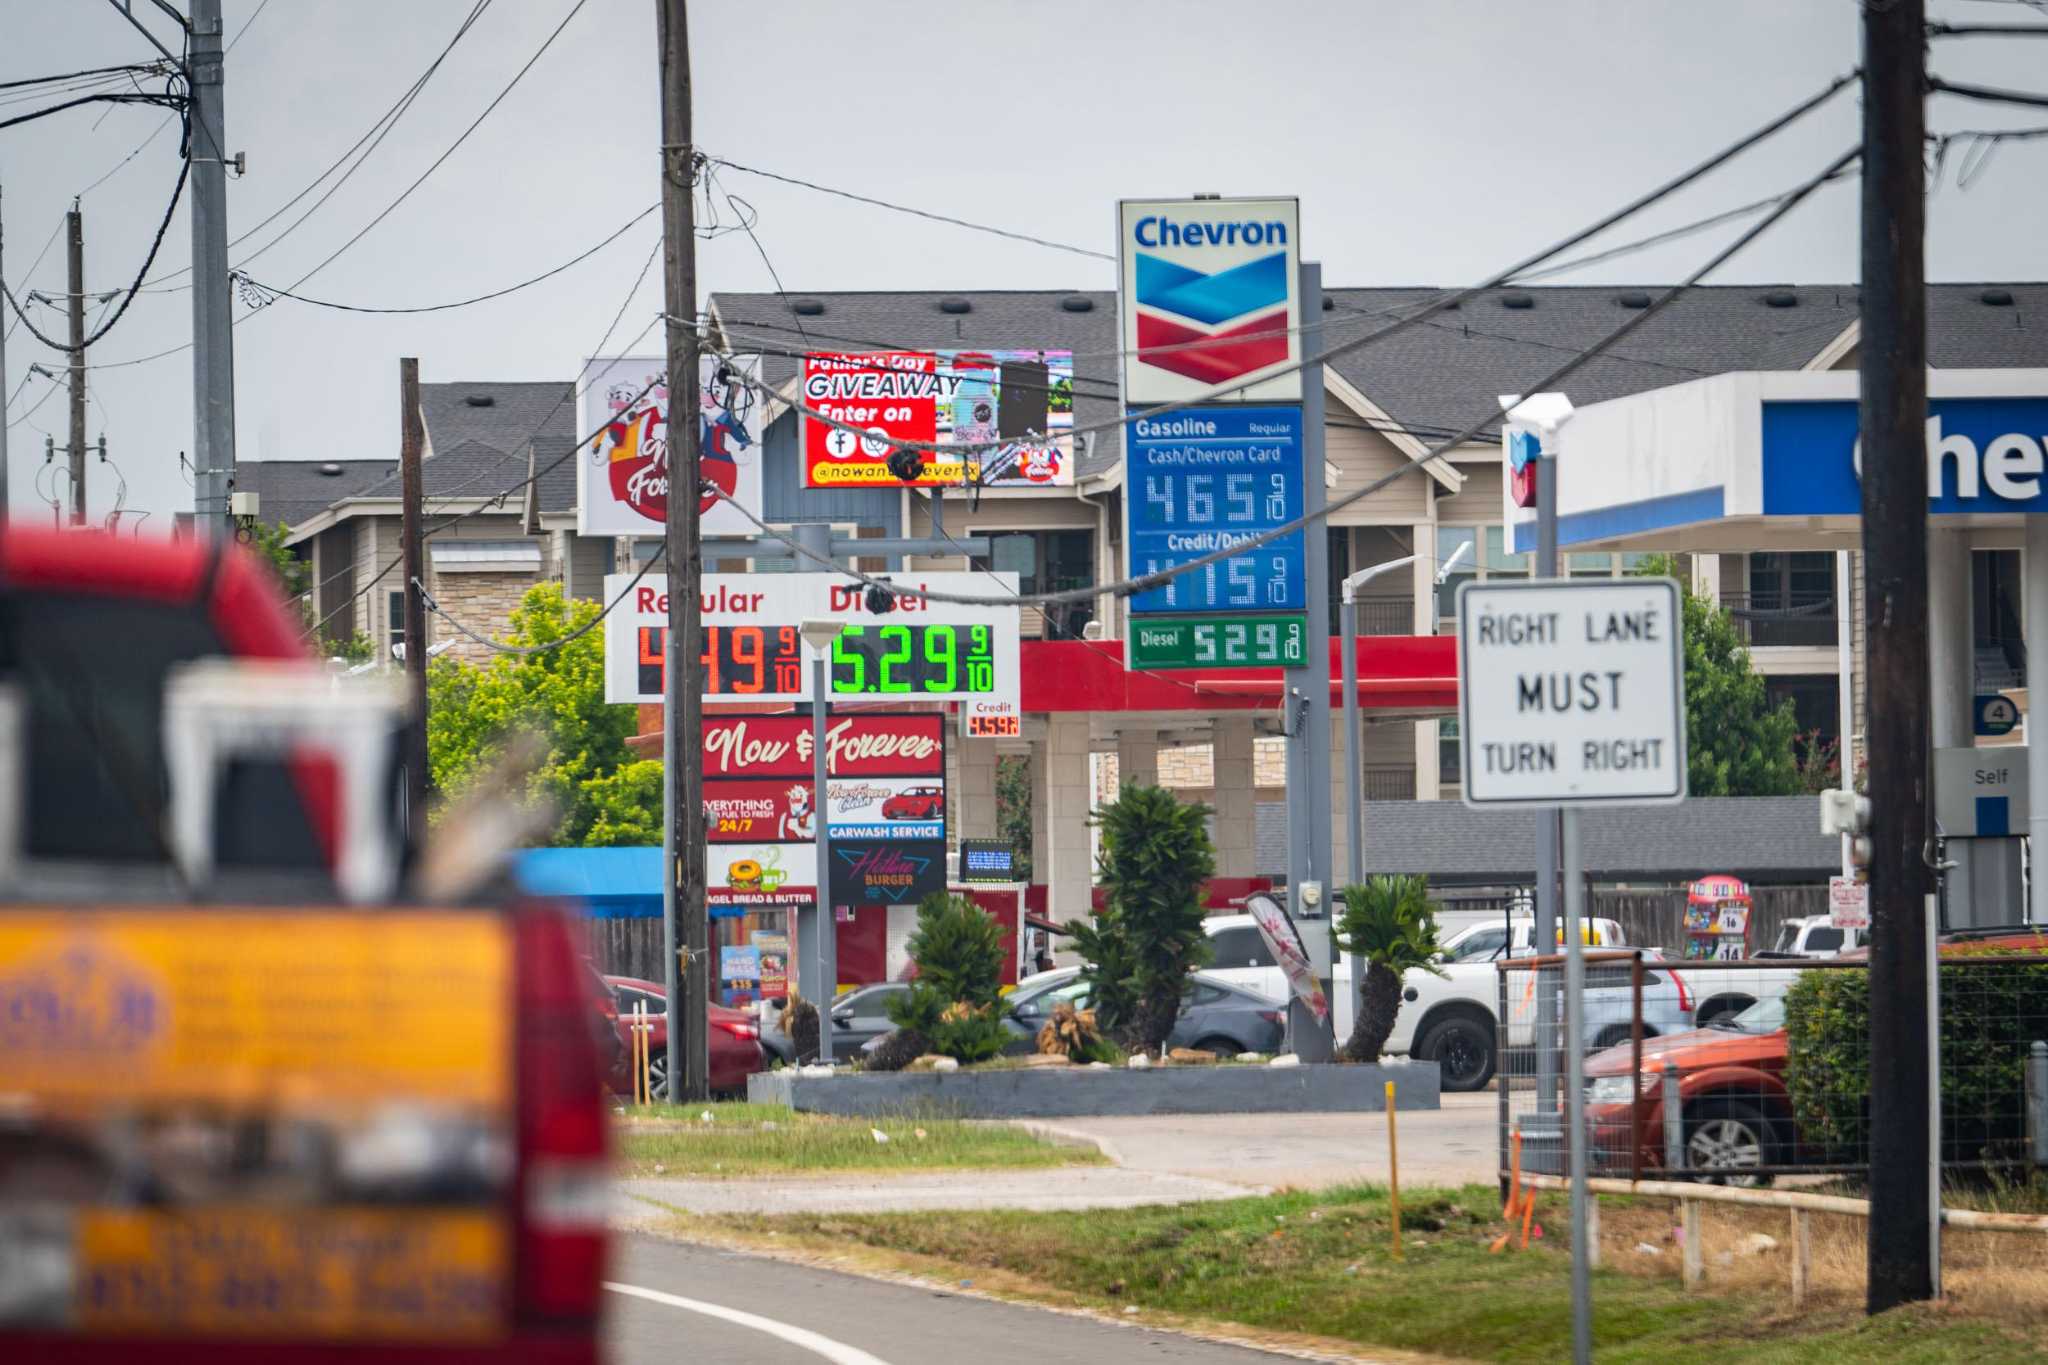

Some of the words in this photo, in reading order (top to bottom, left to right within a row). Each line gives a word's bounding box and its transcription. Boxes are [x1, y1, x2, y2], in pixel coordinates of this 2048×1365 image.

[1135, 215, 1288, 247] Chevron
[891, 354, 926, 372] Day
[807, 373, 967, 399] GIVEAWAY
[818, 404, 877, 423] Enter
[883, 406, 912, 422] on
[1135, 417, 1217, 437] Gasoline
[1249, 422, 1291, 435] Regular
[1147, 446, 1244, 465] Cash/Chevron
[1248, 446, 1281, 462] Card
[1853, 414, 2048, 500] he
[1167, 531, 1264, 551] Credit/Debit
[637, 584, 764, 613] Reular
[1478, 611, 1559, 646] RIGHT
[1585, 609, 1660, 643] LANE
[1140, 631, 1179, 647] Diesel
[831, 624, 957, 694] 5.29
[1517, 672, 1625, 713] MUST
[976, 701, 1011, 713] Credit
[1991, 704, 2006, 720] 4
[705, 720, 790, 773] Now
[825, 717, 937, 774] Forever
[1481, 741, 1558, 774] TURN
[1582, 738, 1664, 771] RIGHT
[1974, 768, 2009, 785] Self
[719, 818, 753, 833] 24/7
[829, 826, 890, 838] CARWASH
[891, 826, 939, 838] SERVICE
[864, 873, 913, 886] BURGER
[707, 894, 732, 904] AGEL
[733, 894, 765, 904] BREAD
[766, 894, 774, 903] &
[776, 894, 812, 903] BUTTER
